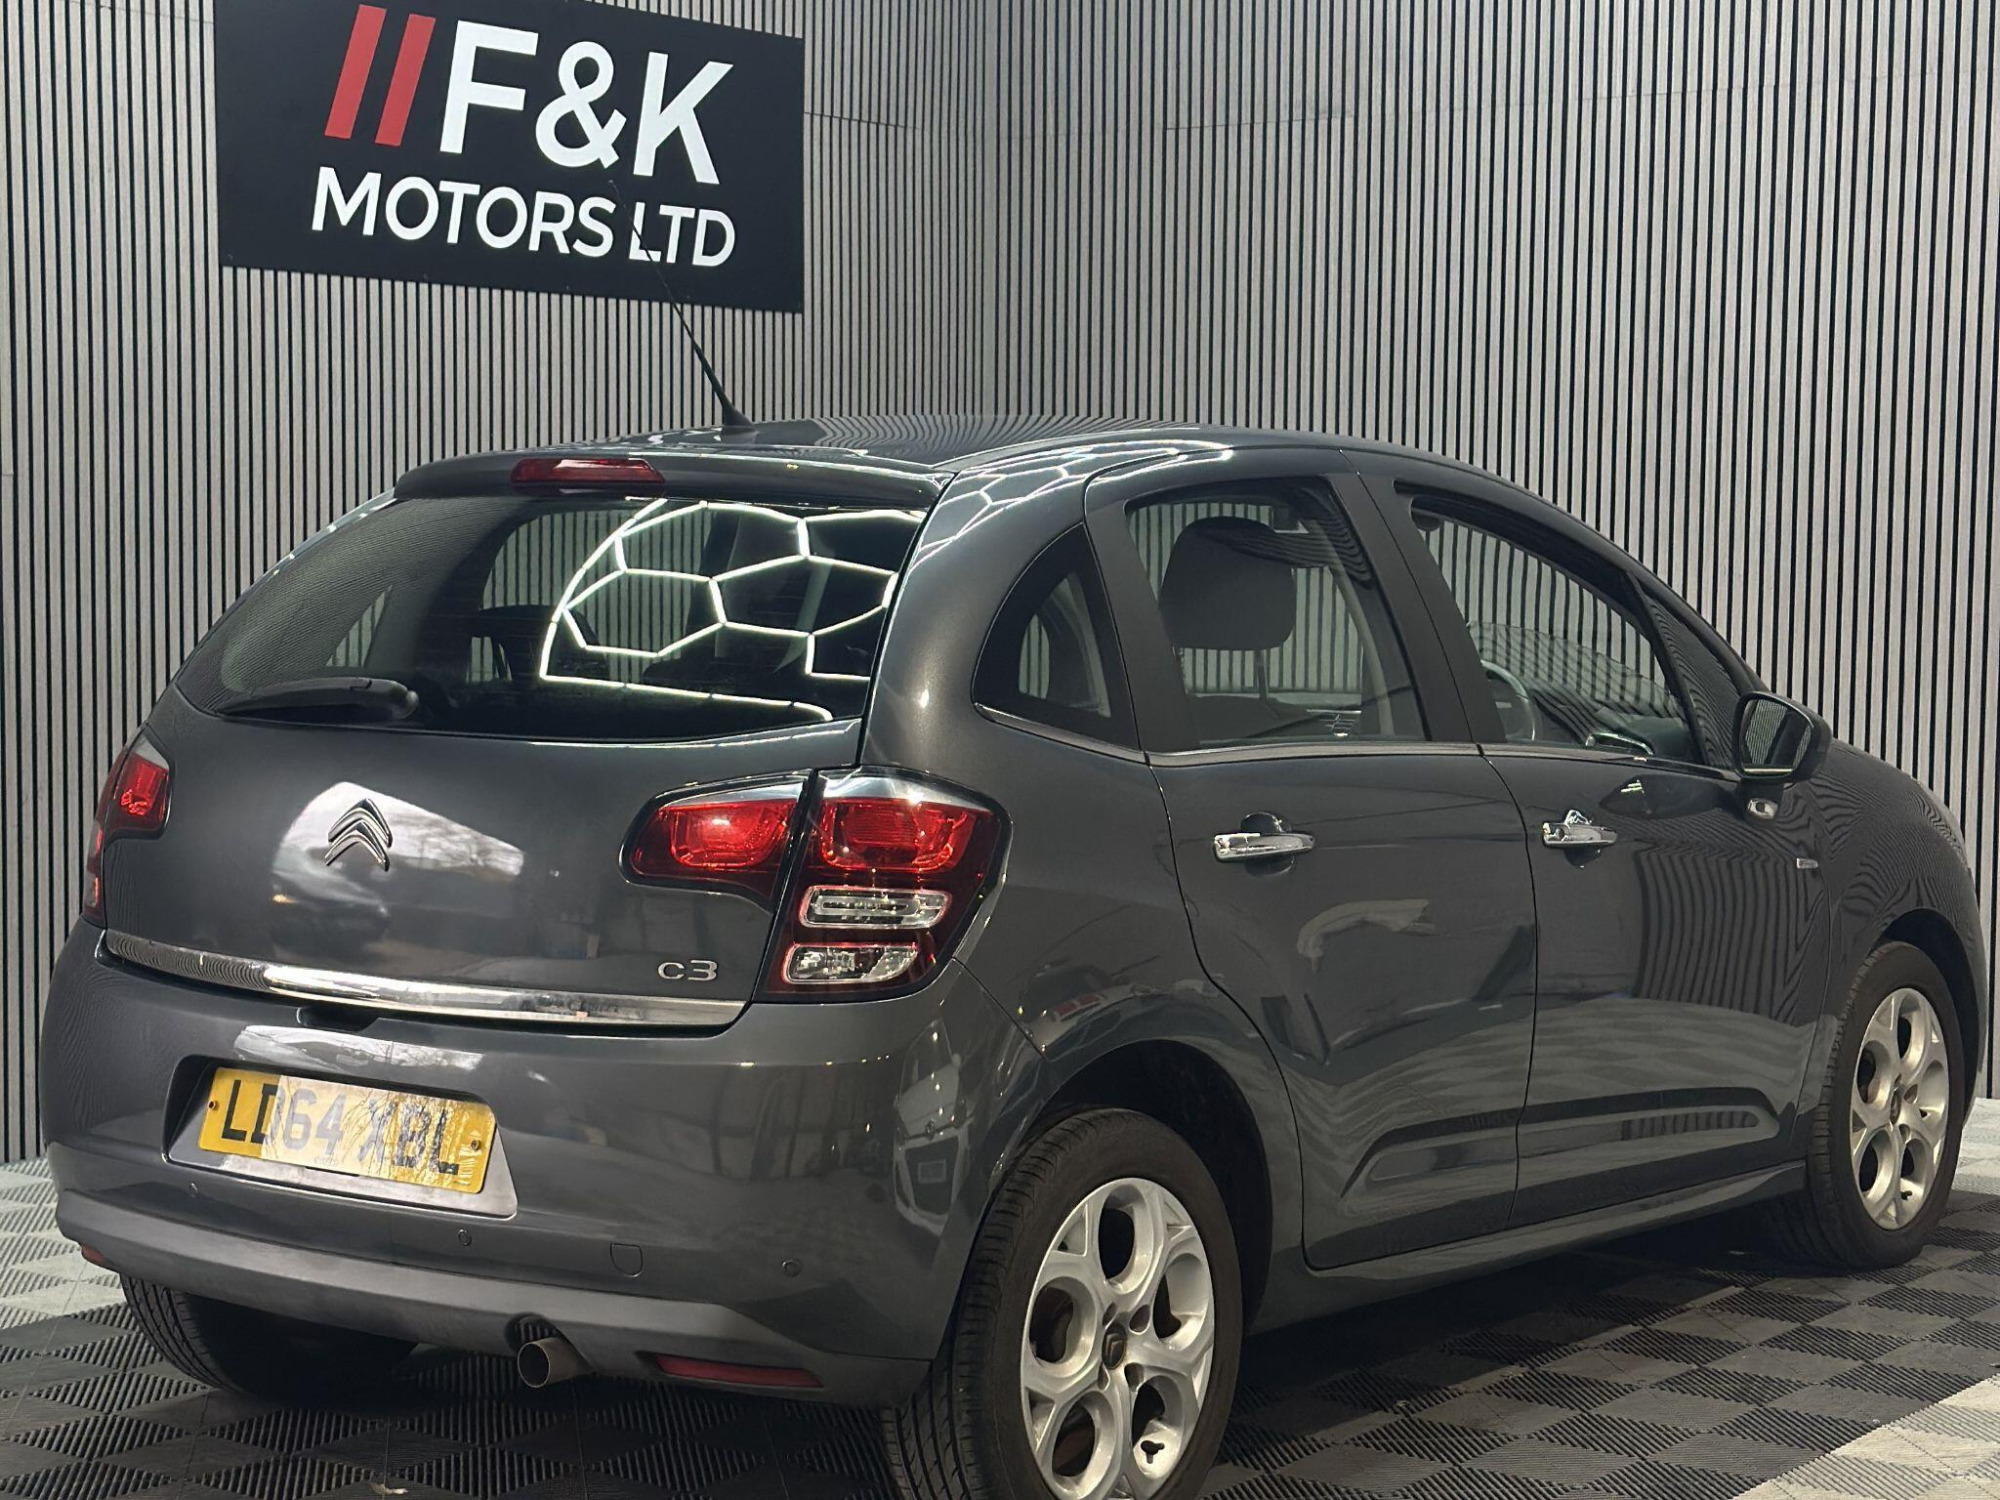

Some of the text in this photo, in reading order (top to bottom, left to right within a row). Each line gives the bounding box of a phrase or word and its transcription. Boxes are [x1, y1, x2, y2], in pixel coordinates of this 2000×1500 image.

[440, 20, 734, 185] F&K
[312, 167, 736, 267] MOTORS LTD
[657, 959, 718, 981] C3
